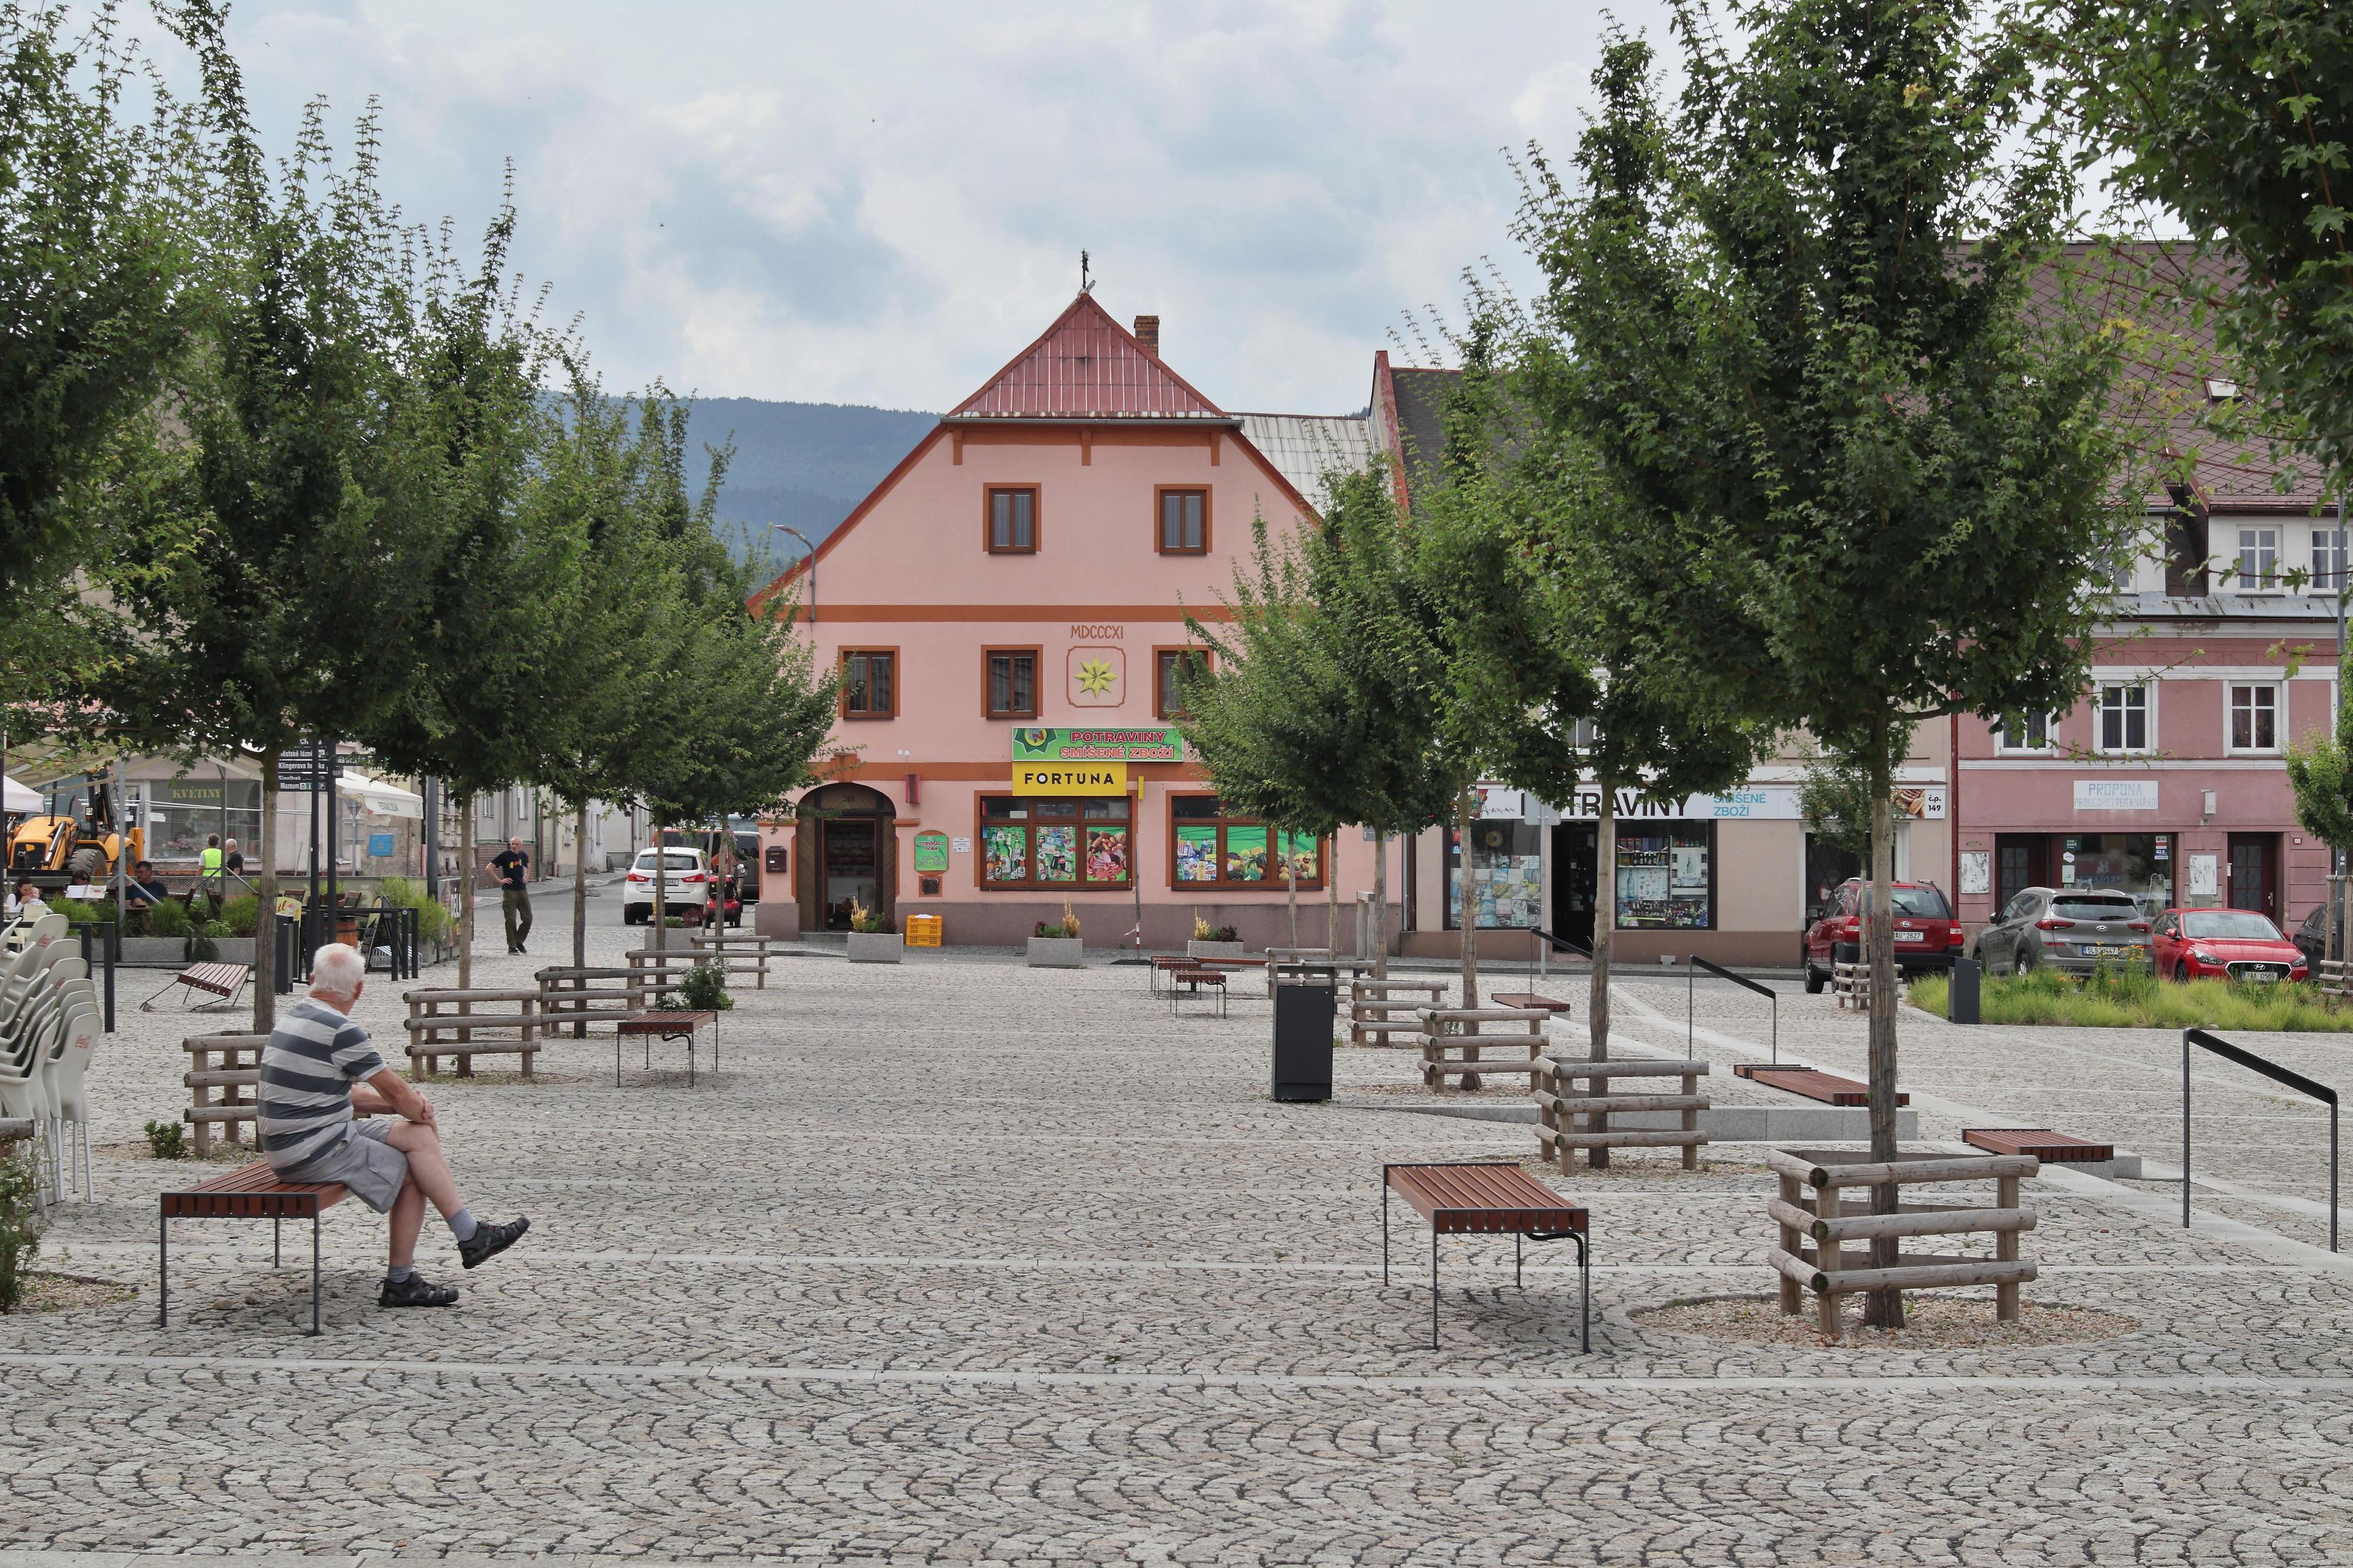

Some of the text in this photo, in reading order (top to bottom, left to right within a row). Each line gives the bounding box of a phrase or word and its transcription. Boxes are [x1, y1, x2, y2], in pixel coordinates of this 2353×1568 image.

[1070, 625, 1123, 639] MDCCCXI
[1071, 731, 1167, 743] POTRAVINY
[1060, 745, 1174, 758] SMÍŠENÉ ZBOŽÍ
[1025, 773, 1114, 785] FORTUNA
[2089, 783, 2143, 796] PROPONA
[1521, 792, 1691, 816] TRAVINY
[1928, 795, 1941, 803] č.p.
[1714, 805, 1749, 816] ZBOŽÍ
